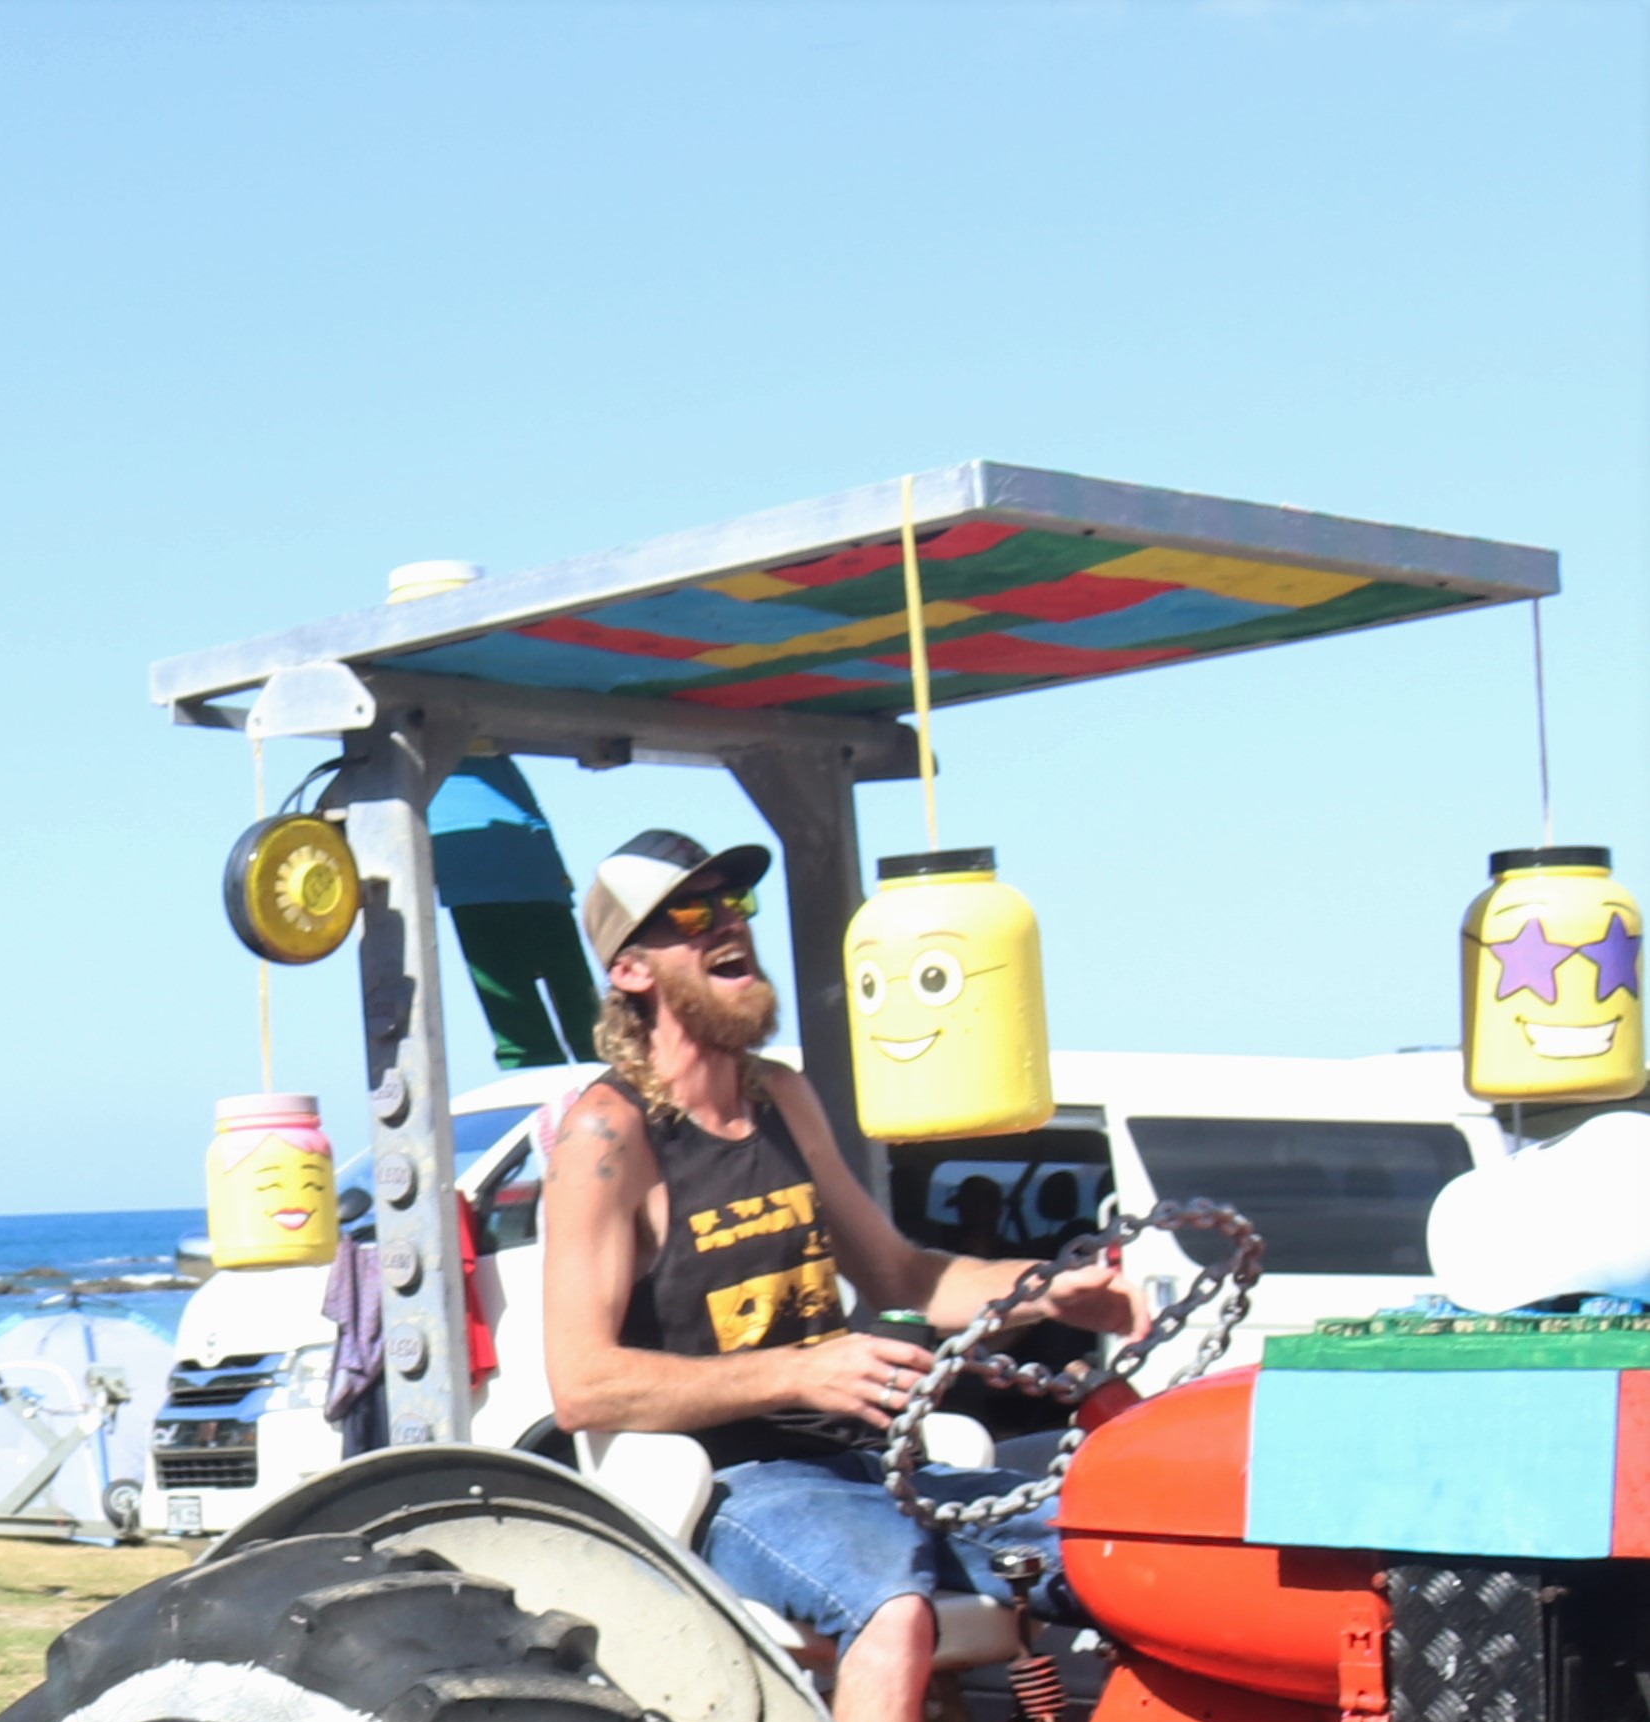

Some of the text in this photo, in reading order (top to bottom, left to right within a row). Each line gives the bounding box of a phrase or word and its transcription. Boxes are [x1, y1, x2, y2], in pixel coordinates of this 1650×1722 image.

[377, 1167, 409, 1185] LEGO
[382, 1254, 412, 1270] LEGO
[388, 1338, 419, 1357] LEGO
